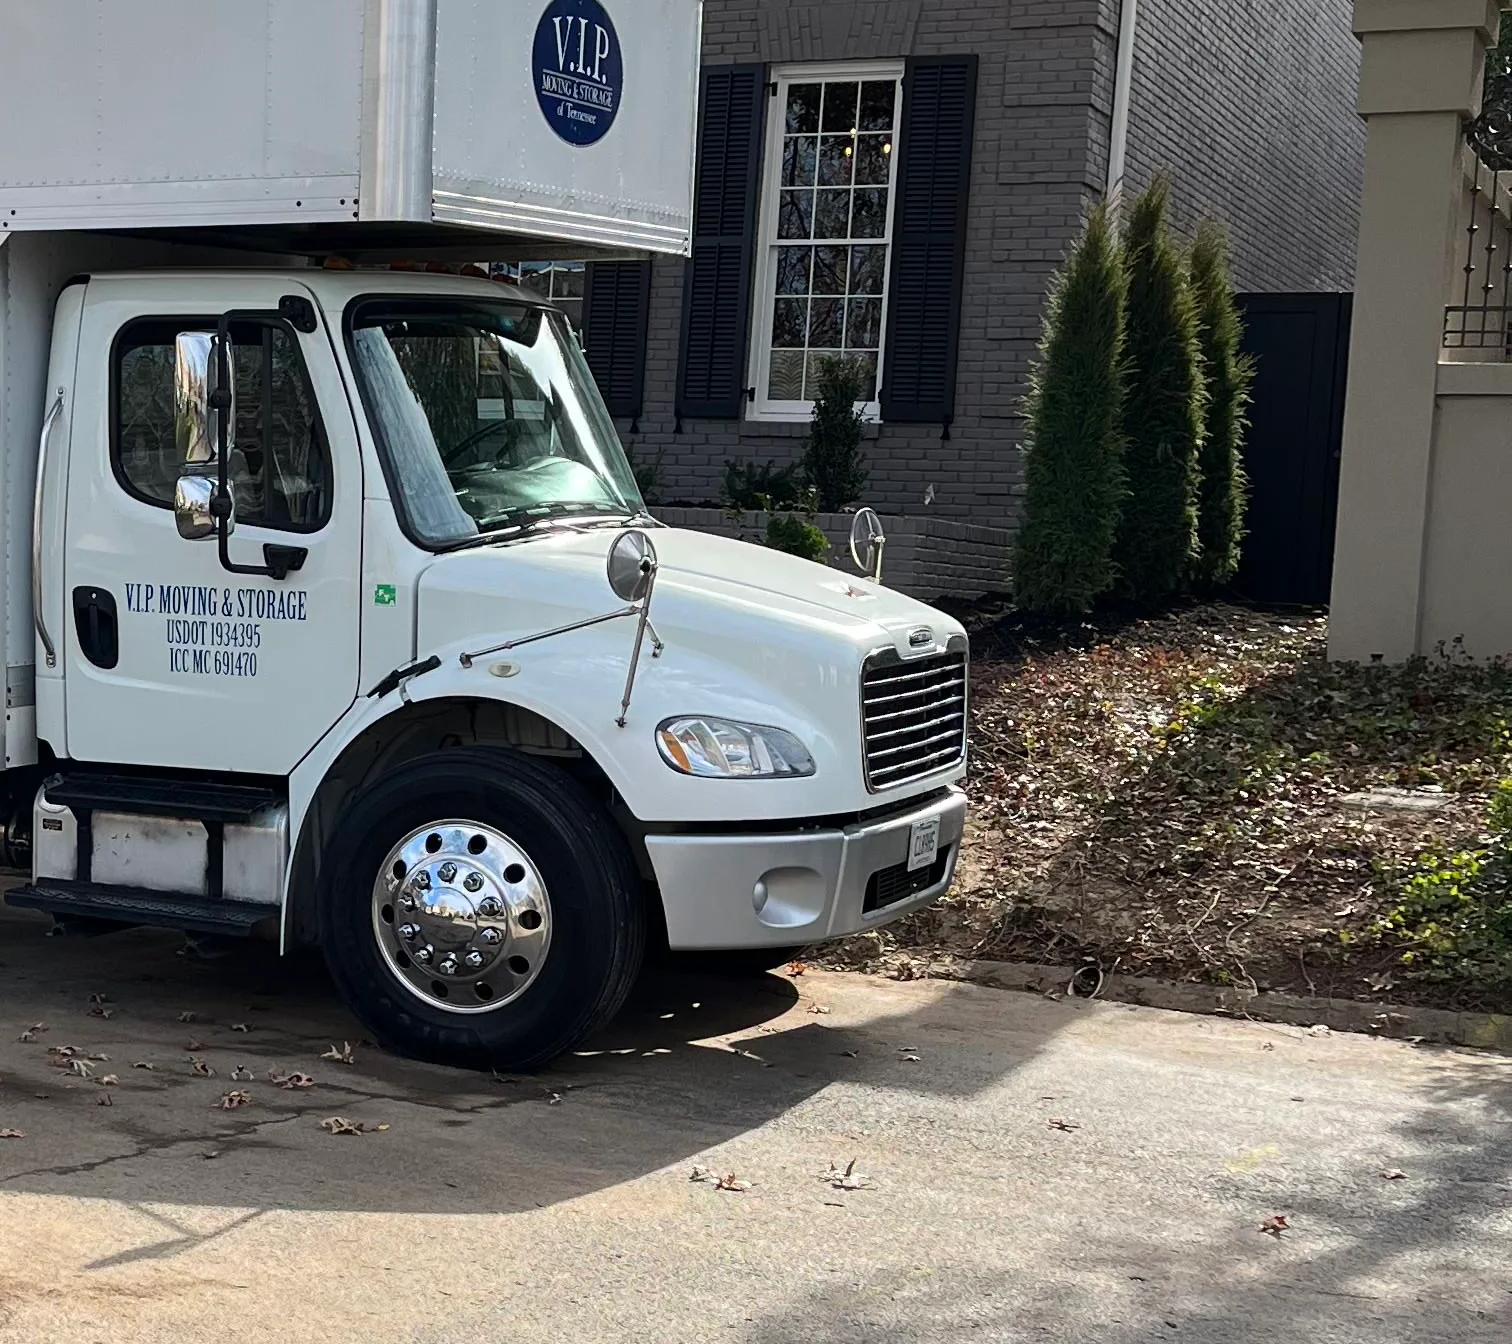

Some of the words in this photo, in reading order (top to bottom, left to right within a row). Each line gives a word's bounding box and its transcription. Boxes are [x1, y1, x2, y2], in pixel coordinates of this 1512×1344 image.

[553, 16, 609, 84] V.I.P.
[542, 74, 571, 96] MOVING
[579, 84, 613, 107] STORAGE
[557, 101, 565, 116] of
[125, 583, 156, 613] V.I.P.
[158, 584, 218, 617] MOVING
[221, 588, 234, 617] &
[237, 588, 307, 621] STORAGE
[166, 619, 207, 646] USDOT
[210, 621, 261, 648] 1934395
[169, 647, 189, 673] ICC
[192, 648, 211, 674] MC
[214, 650, 257, 677] 691470
